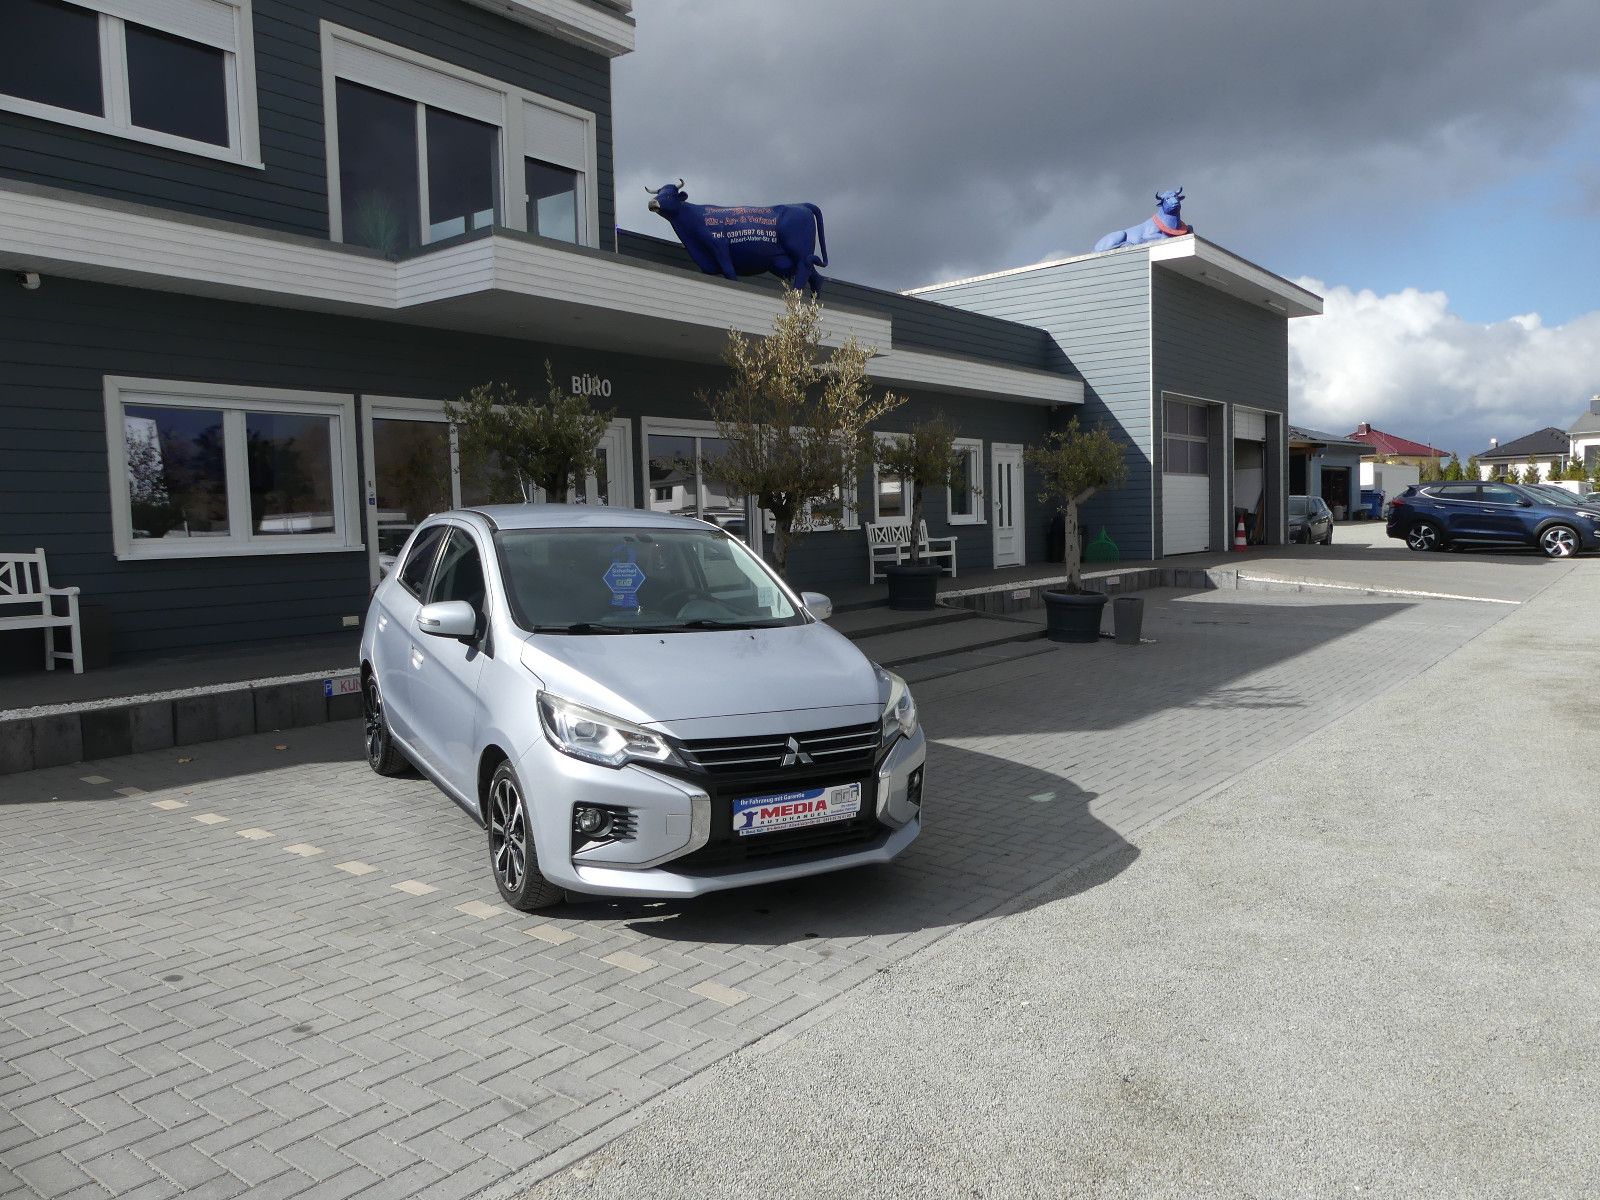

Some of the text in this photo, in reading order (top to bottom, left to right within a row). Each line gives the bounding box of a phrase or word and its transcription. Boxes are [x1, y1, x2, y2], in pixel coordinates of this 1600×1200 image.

[572, 374, 611, 397] BÜRO
[326, 684, 332, 693] P
[760, 800, 827, 819] MEDIA
[760, 811, 827, 824] AUTOHANDEL
